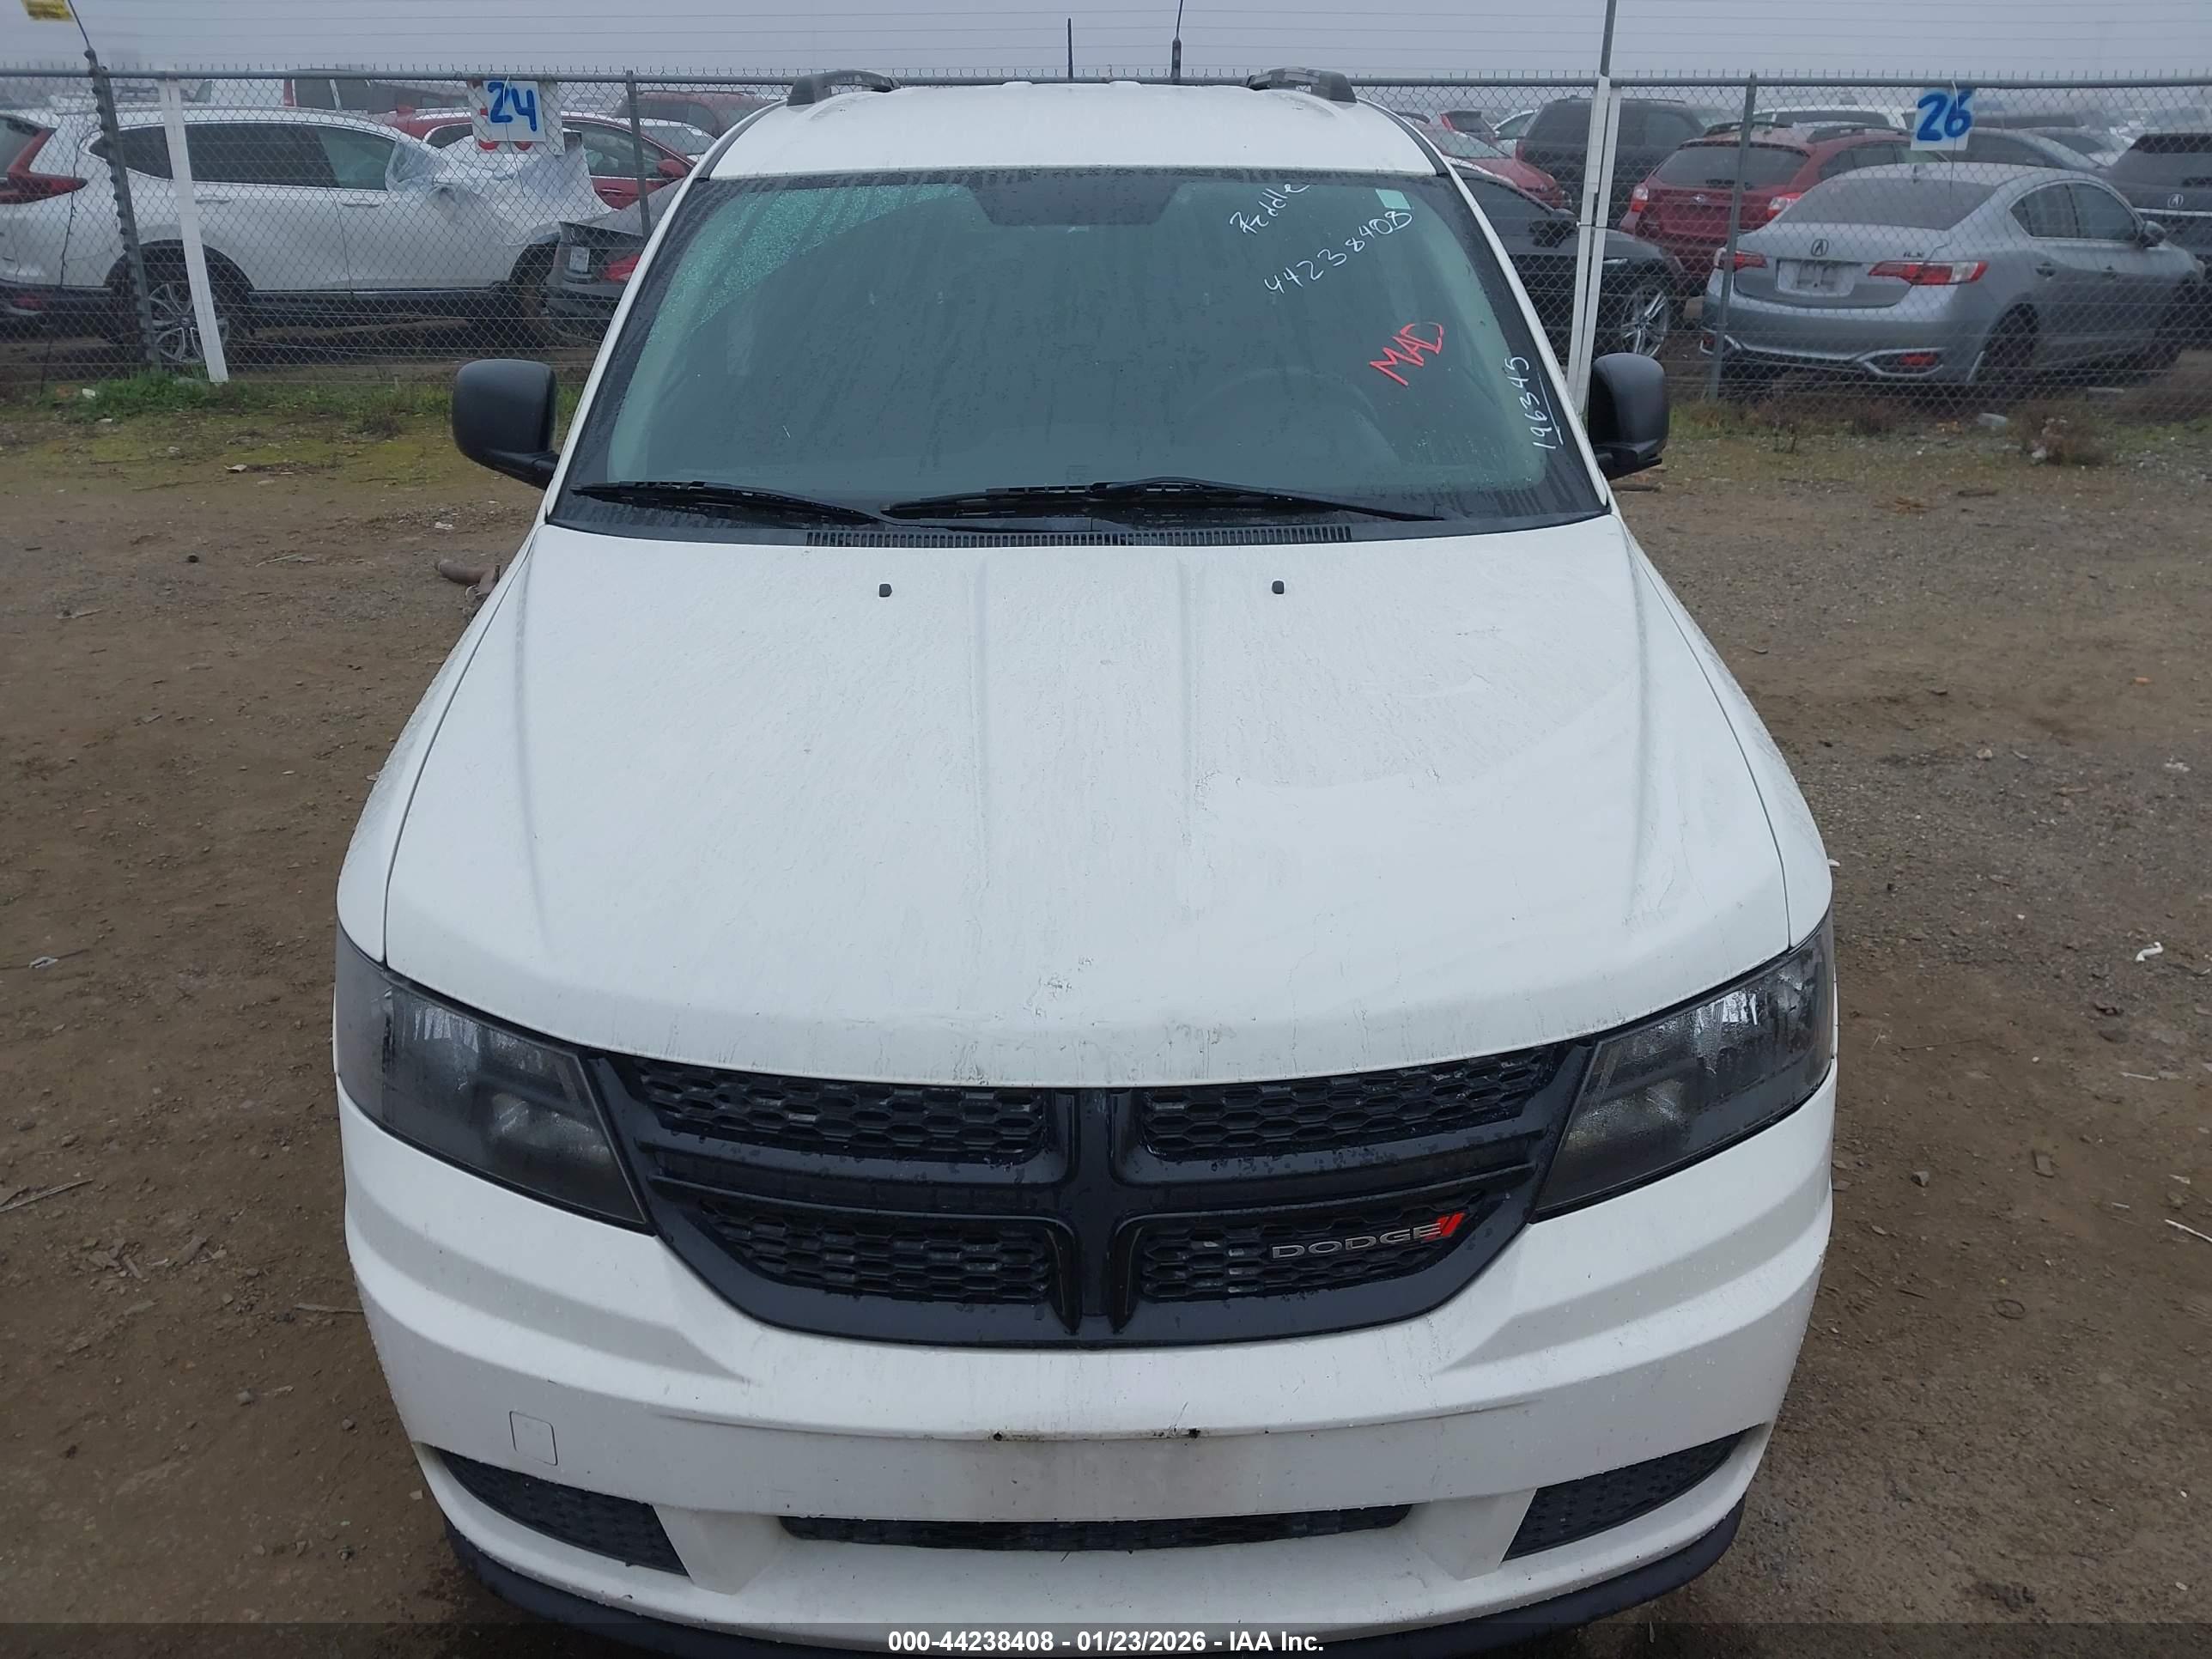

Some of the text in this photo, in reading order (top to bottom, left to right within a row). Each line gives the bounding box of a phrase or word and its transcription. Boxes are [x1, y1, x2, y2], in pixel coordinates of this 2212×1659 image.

[488, 82, 538, 132] 24
[1917, 90, 1973, 141] 26
[1272, 1222, 1442, 1260] DODGE
